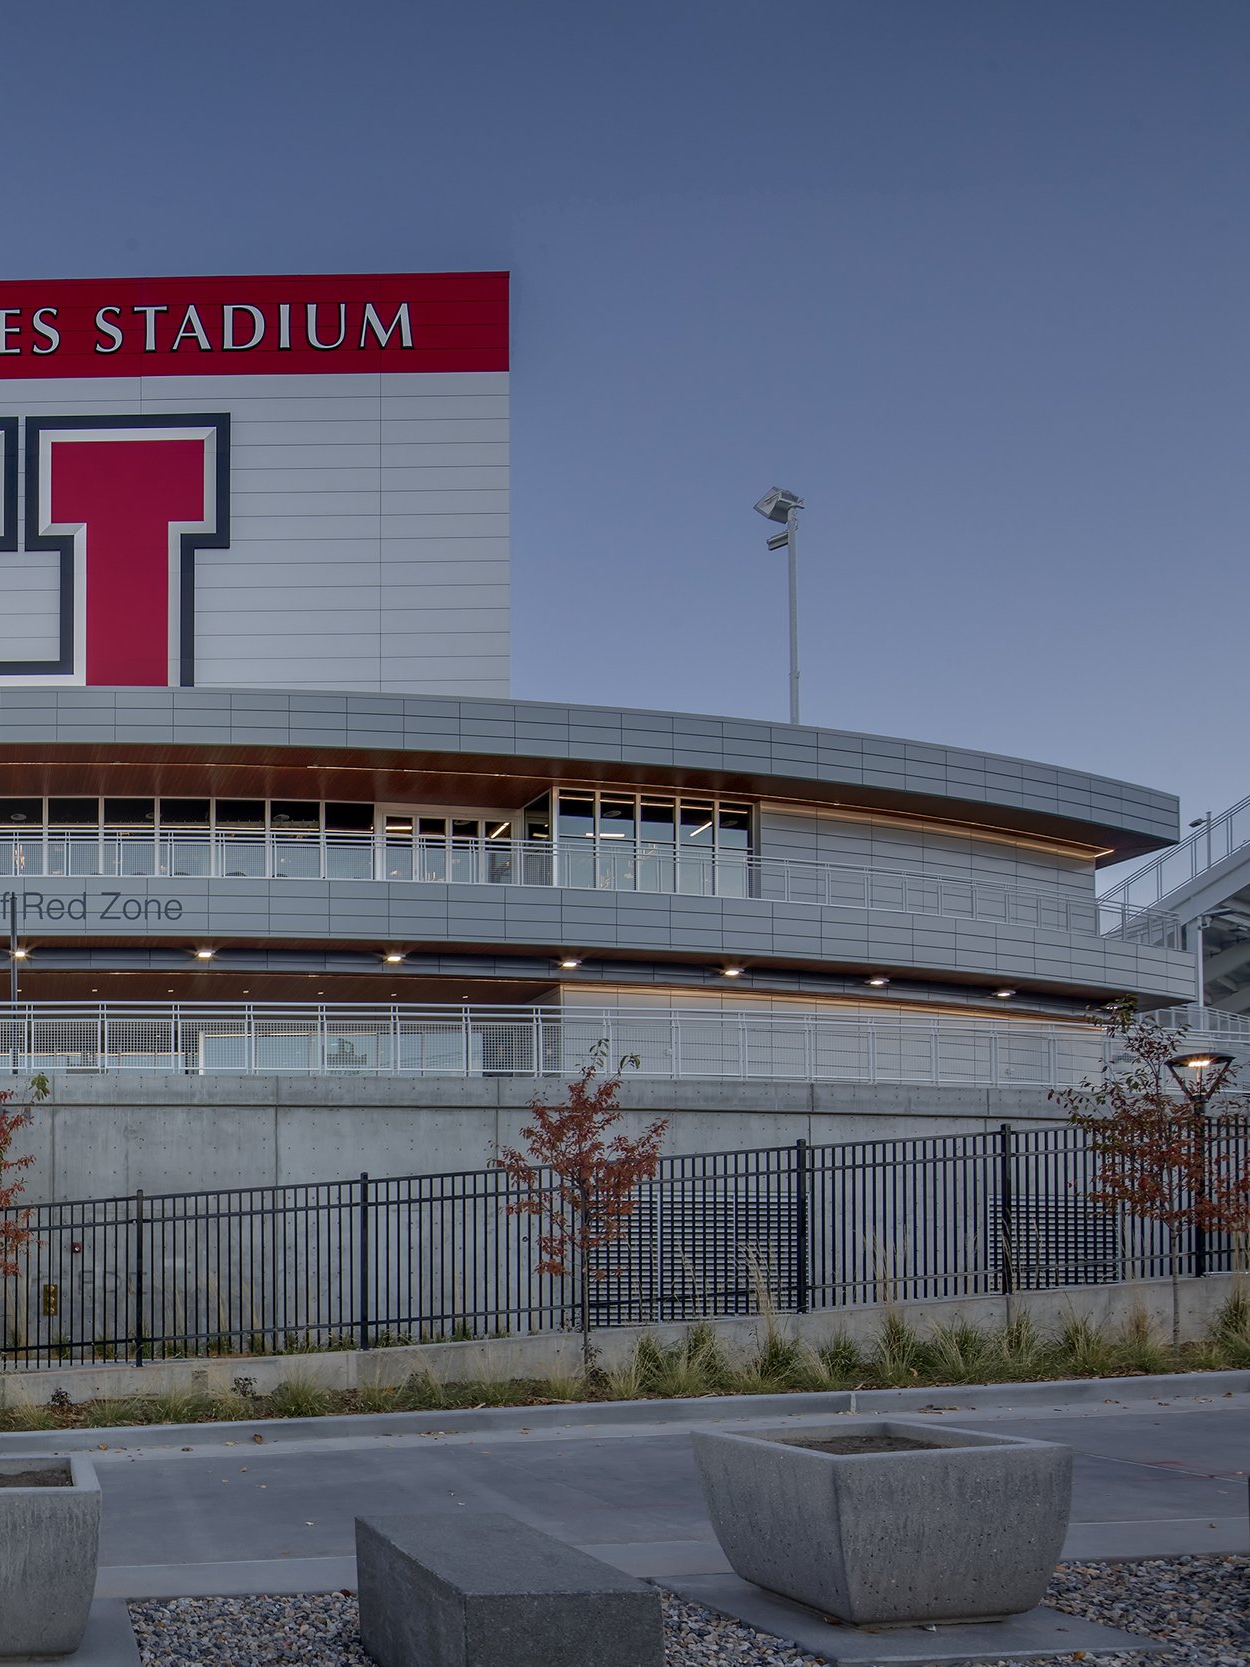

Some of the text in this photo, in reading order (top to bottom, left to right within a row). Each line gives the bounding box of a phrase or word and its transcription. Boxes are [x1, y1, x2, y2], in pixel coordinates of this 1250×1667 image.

[94, 303, 414, 353] STADIUM
[23, 891, 87, 920] Red
[99, 891, 183, 920] Zone
